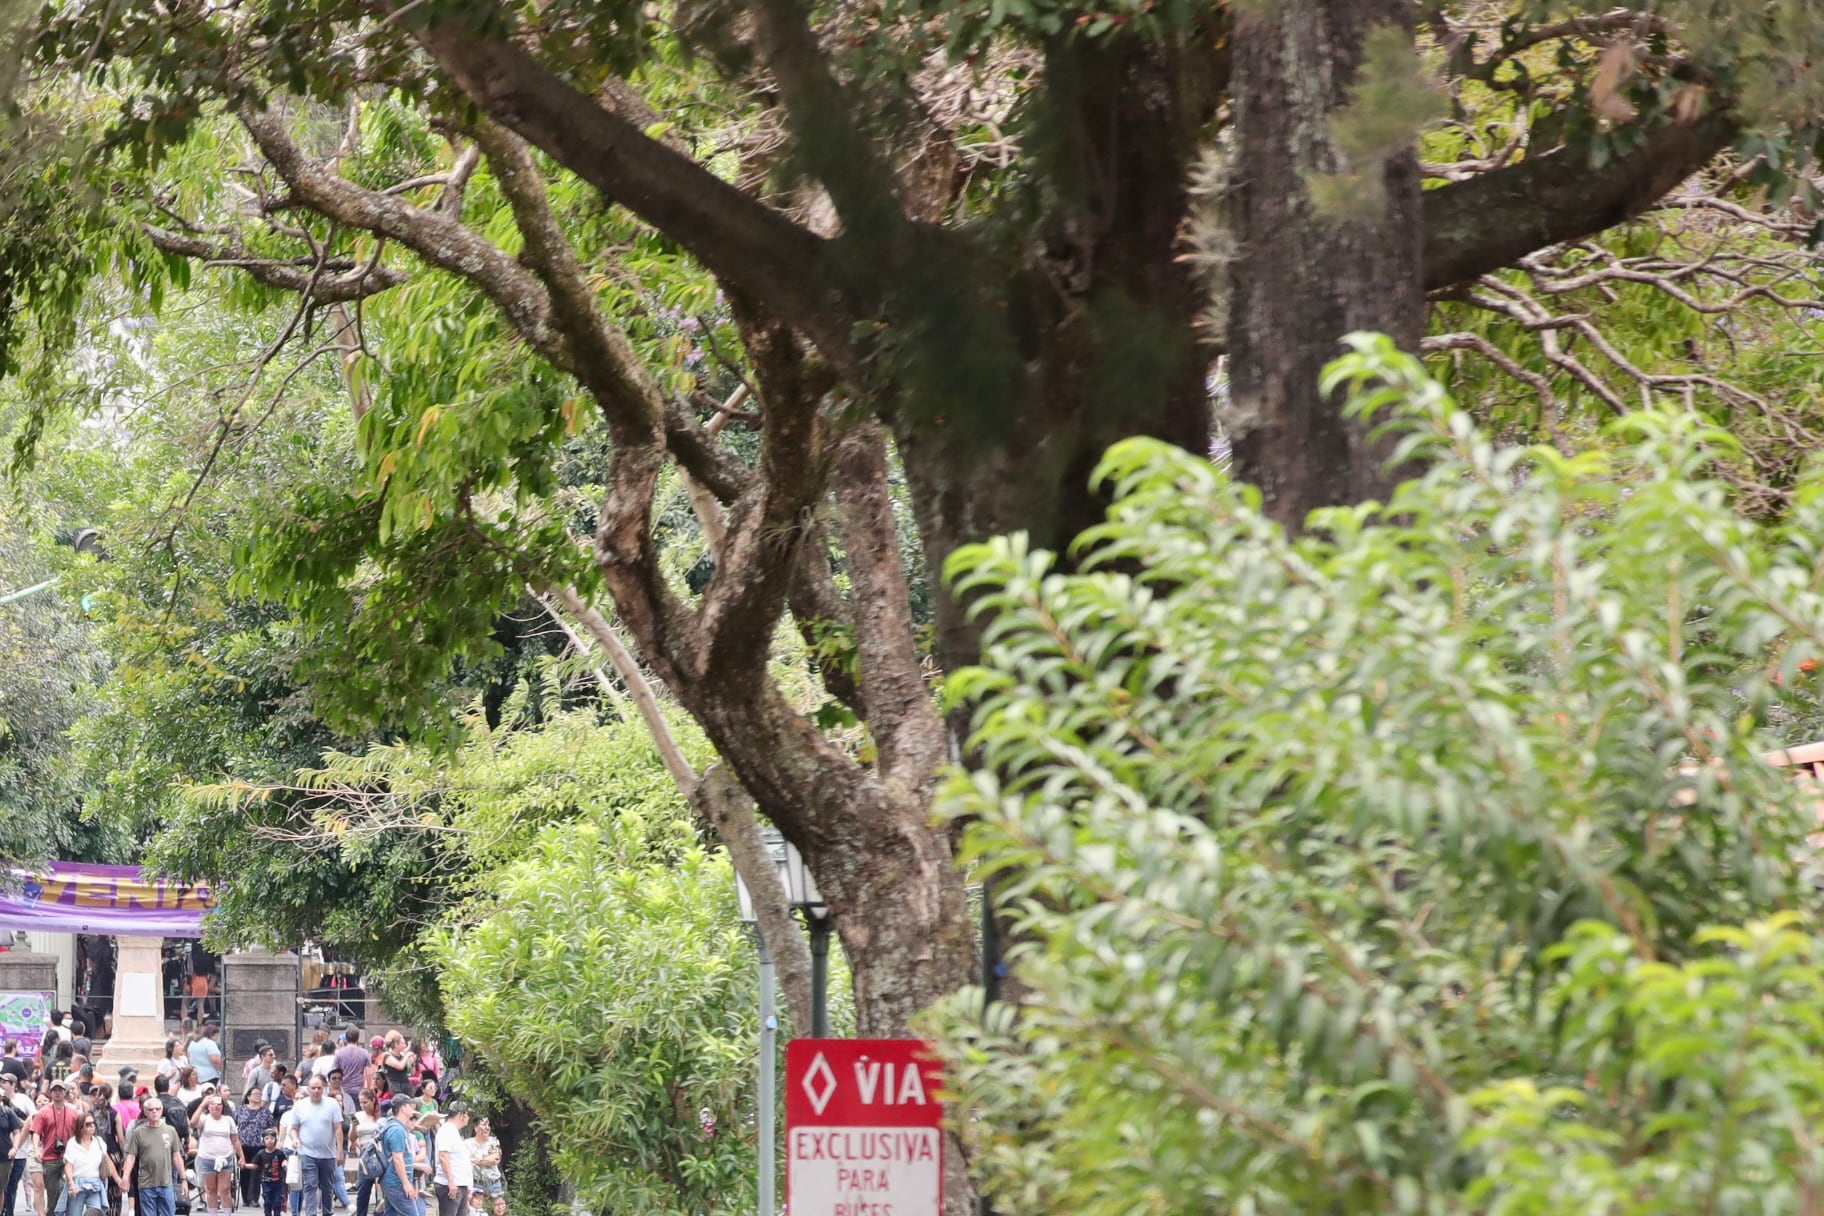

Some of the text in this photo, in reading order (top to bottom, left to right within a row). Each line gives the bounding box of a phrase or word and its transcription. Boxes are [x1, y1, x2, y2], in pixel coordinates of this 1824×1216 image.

[853, 1062, 927, 1105] VIA
[796, 1132, 934, 1161] EXCLUSIVA
[837, 1168, 890, 1193] PARA
